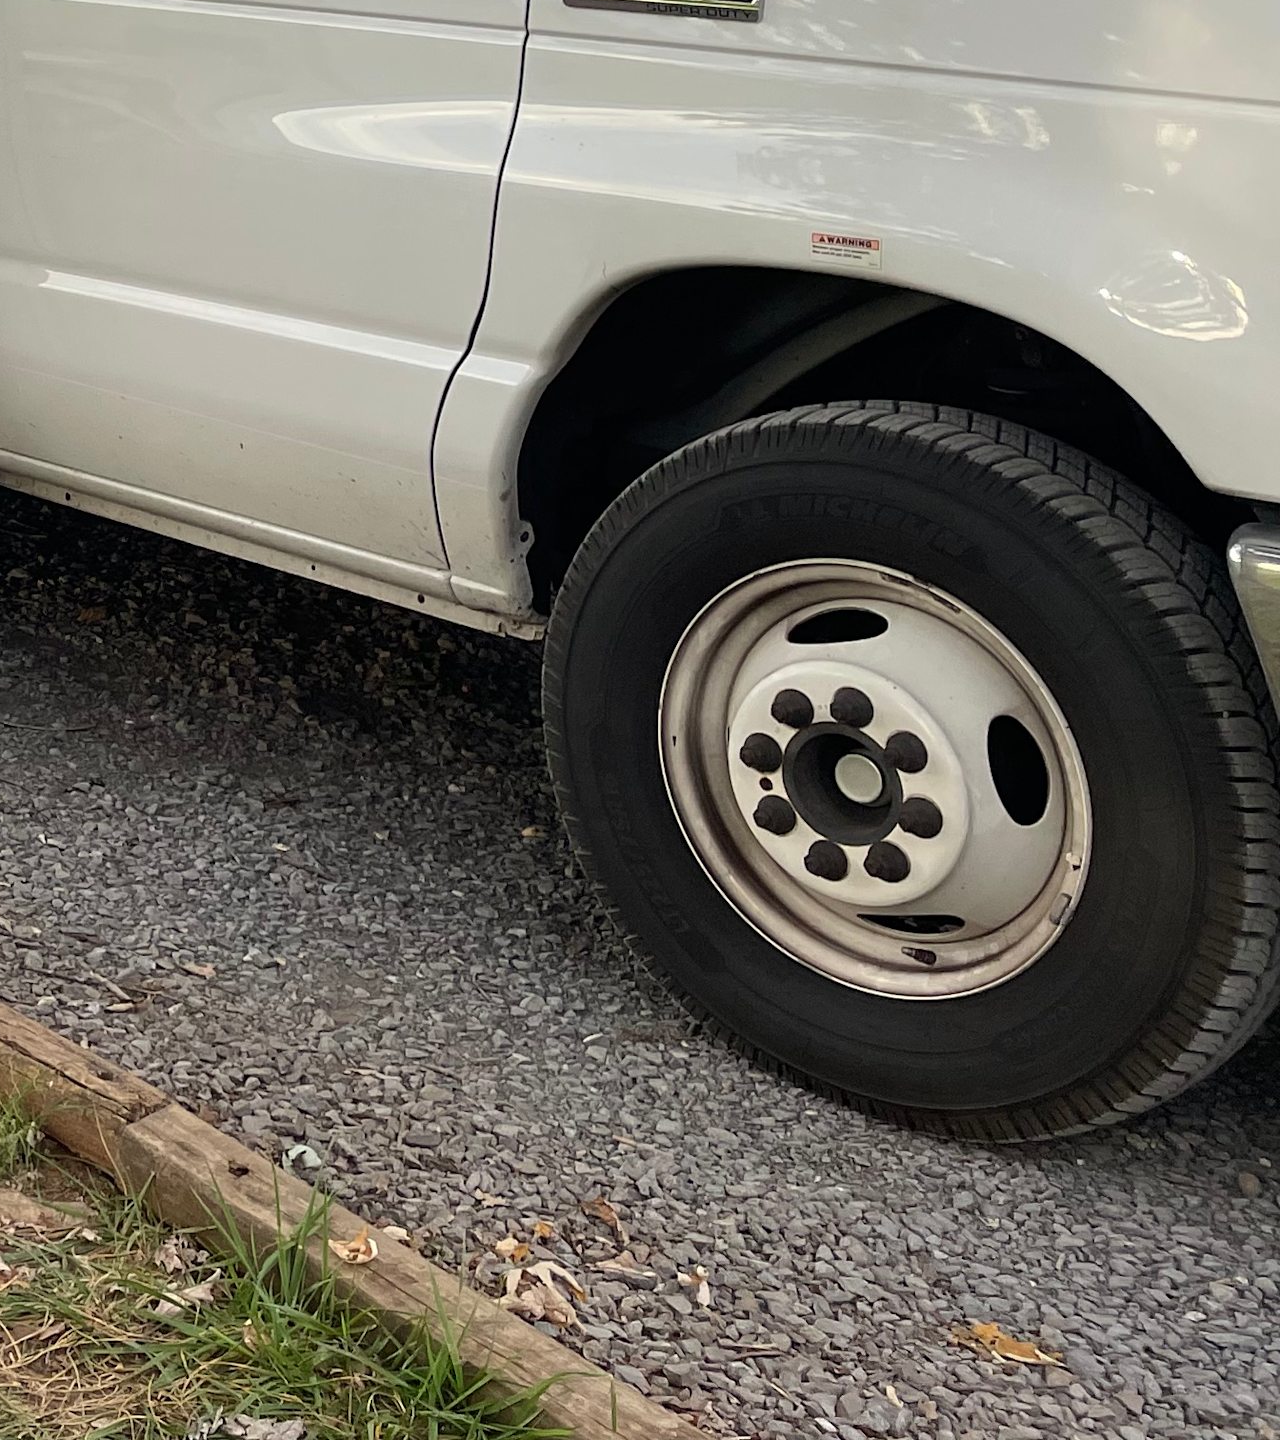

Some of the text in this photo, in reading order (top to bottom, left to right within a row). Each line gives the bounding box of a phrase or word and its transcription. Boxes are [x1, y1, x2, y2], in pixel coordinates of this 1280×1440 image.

[646, 3, 752, 19] SUPER DUTY
[827, 236, 872, 248] WARNING
